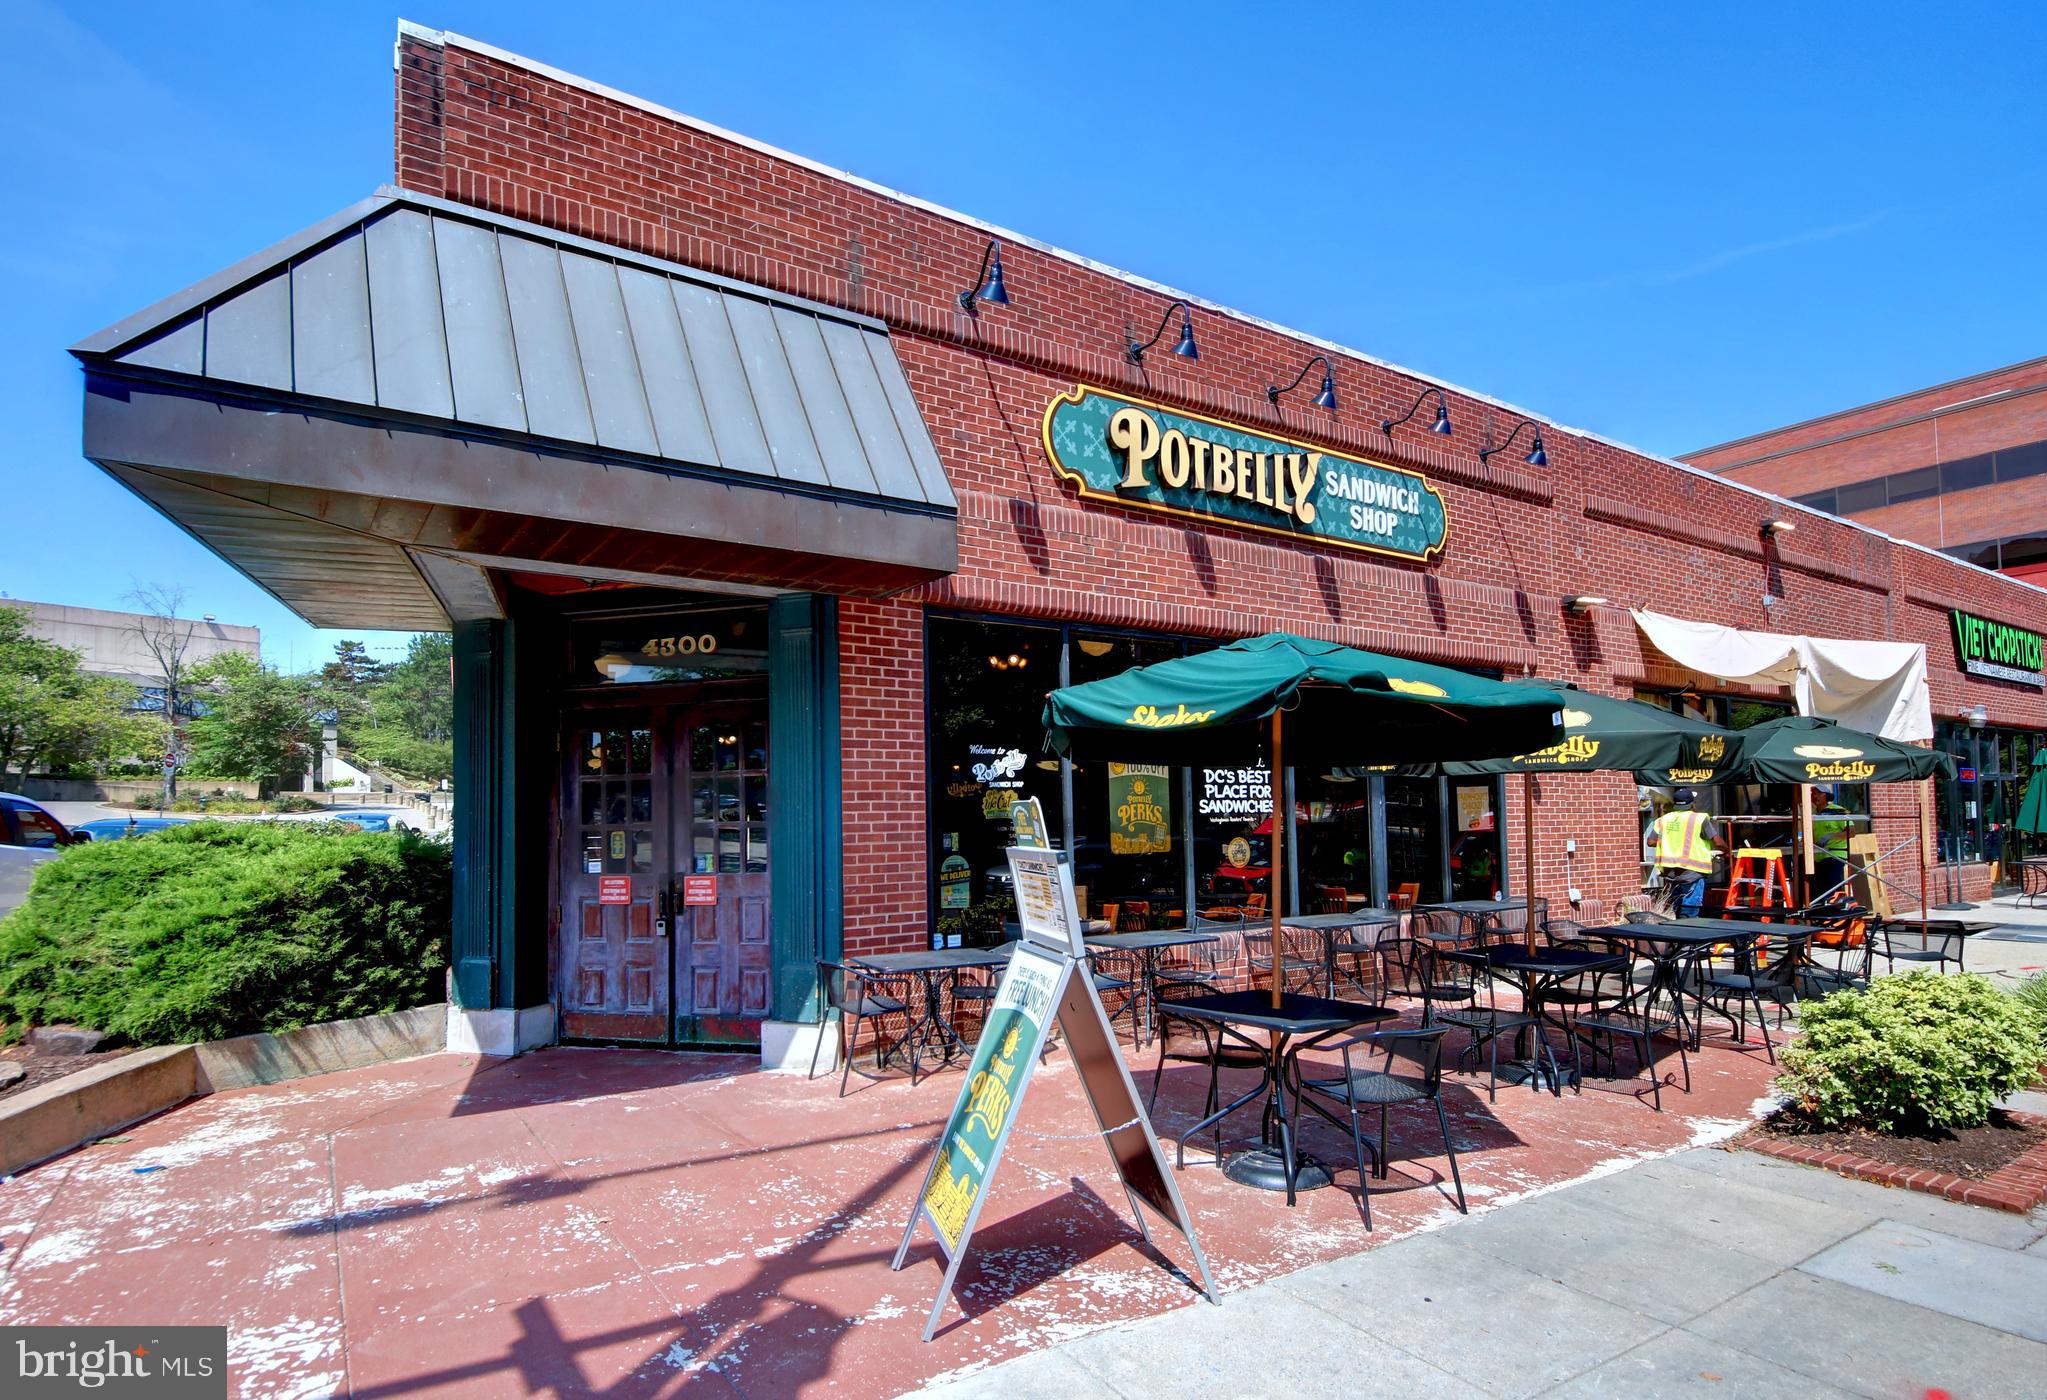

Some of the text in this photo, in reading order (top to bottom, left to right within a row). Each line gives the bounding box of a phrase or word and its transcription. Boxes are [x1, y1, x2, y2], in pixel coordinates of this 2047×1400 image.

[1109, 406, 1323, 525] POTBELLY
[1325, 470, 1420, 515] SANDWICH
[1349, 505, 1398, 536] SHOP
[641, 634, 717, 657] 4300
[1955, 609, 2044, 671] VIET CHOPSTICKS
[969, 744, 996, 754] Welcome
[1237, 768, 1271, 784] BEST
[1805, 760, 1876, 778] Potbelly
[1204, 785, 1272, 798] PLACE FOR
[1117, 803, 1163, 832] PERKS
[1199, 799, 1273, 813] SANDWICHES
[941, 869, 971, 881] WE DELIVER
[1005, 978, 1027, 1005] FREE
[964, 1070, 1011, 1140] PERKS
